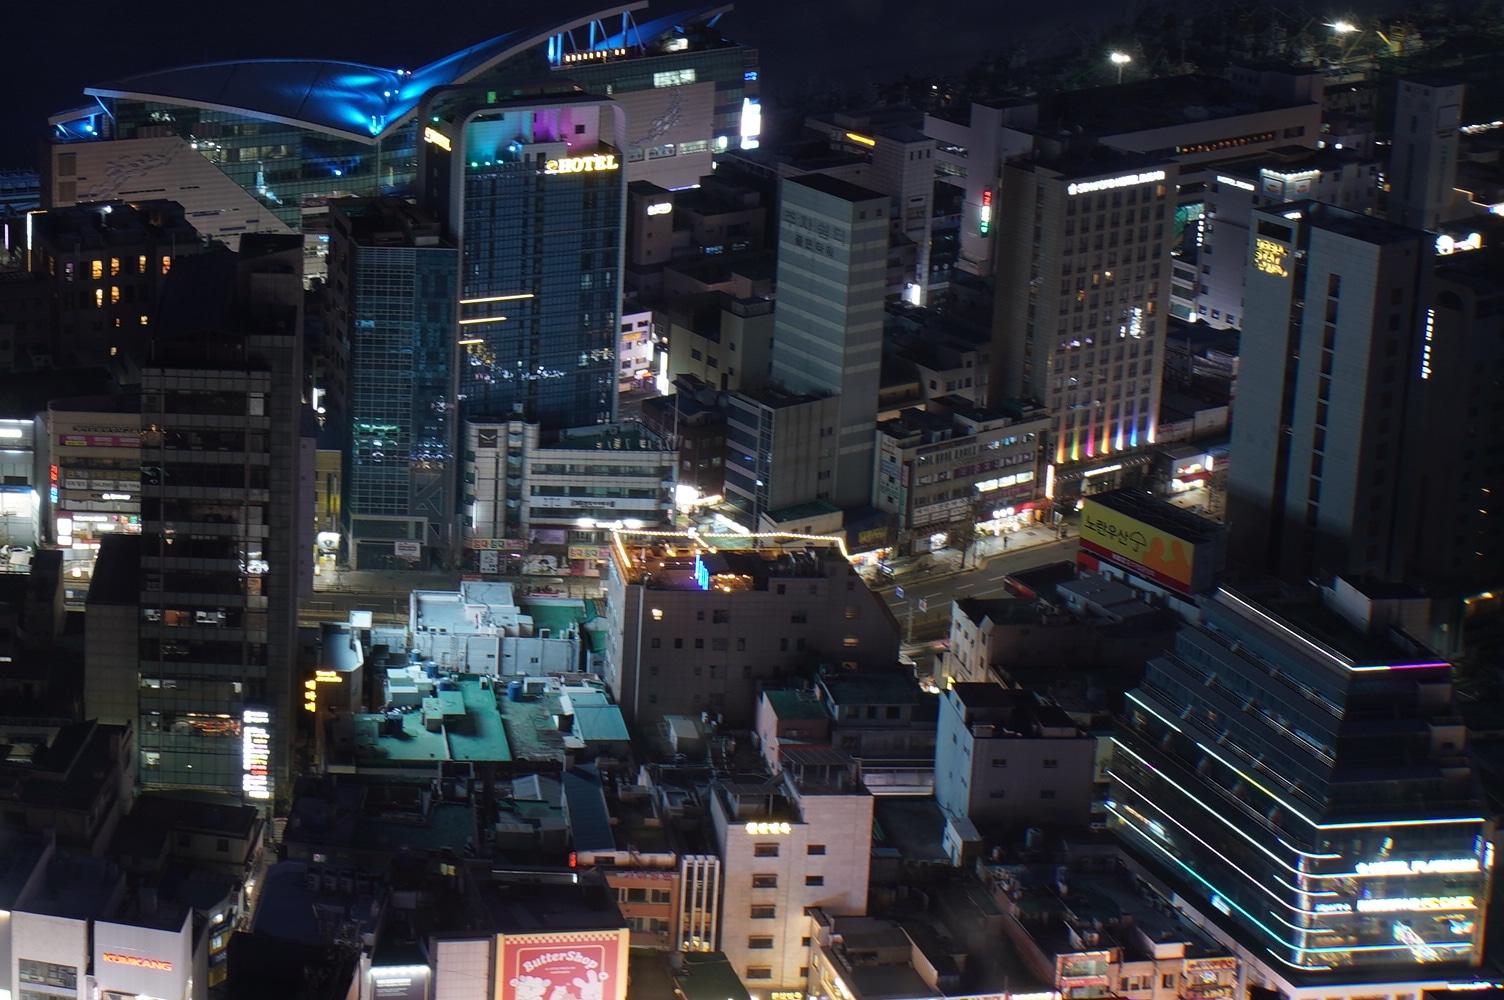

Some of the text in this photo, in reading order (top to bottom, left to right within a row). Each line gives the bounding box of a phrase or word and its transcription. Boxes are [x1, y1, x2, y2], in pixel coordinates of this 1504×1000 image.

[557, 154, 619, 174] HOTEL
[1084, 514, 1130, 546] 노란우산
[102, 952, 173, 972] KUMKANG
[522, 951, 599, 973] ButterShop
